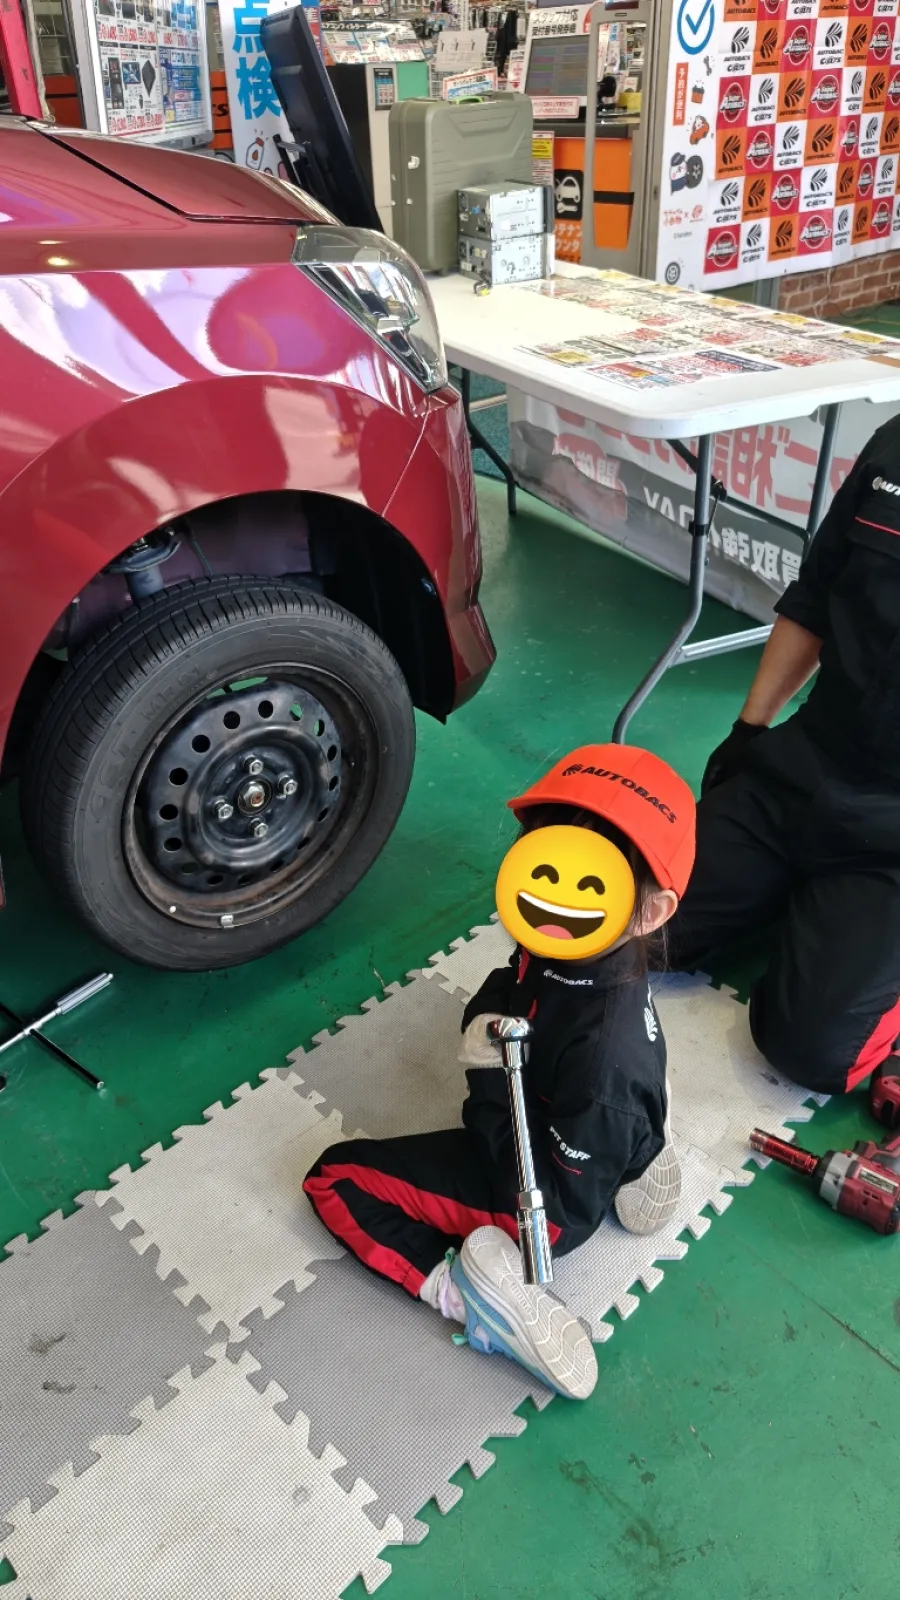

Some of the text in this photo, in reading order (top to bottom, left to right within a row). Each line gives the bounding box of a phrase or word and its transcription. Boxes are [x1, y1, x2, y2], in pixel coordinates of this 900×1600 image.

[231, 0, 281, 120] 点検
[580, 765, 678, 824] AUTOBACS
[551, 973, 594, 986] AUTOBACS
[559, 1142, 592, 1161] STAFF
